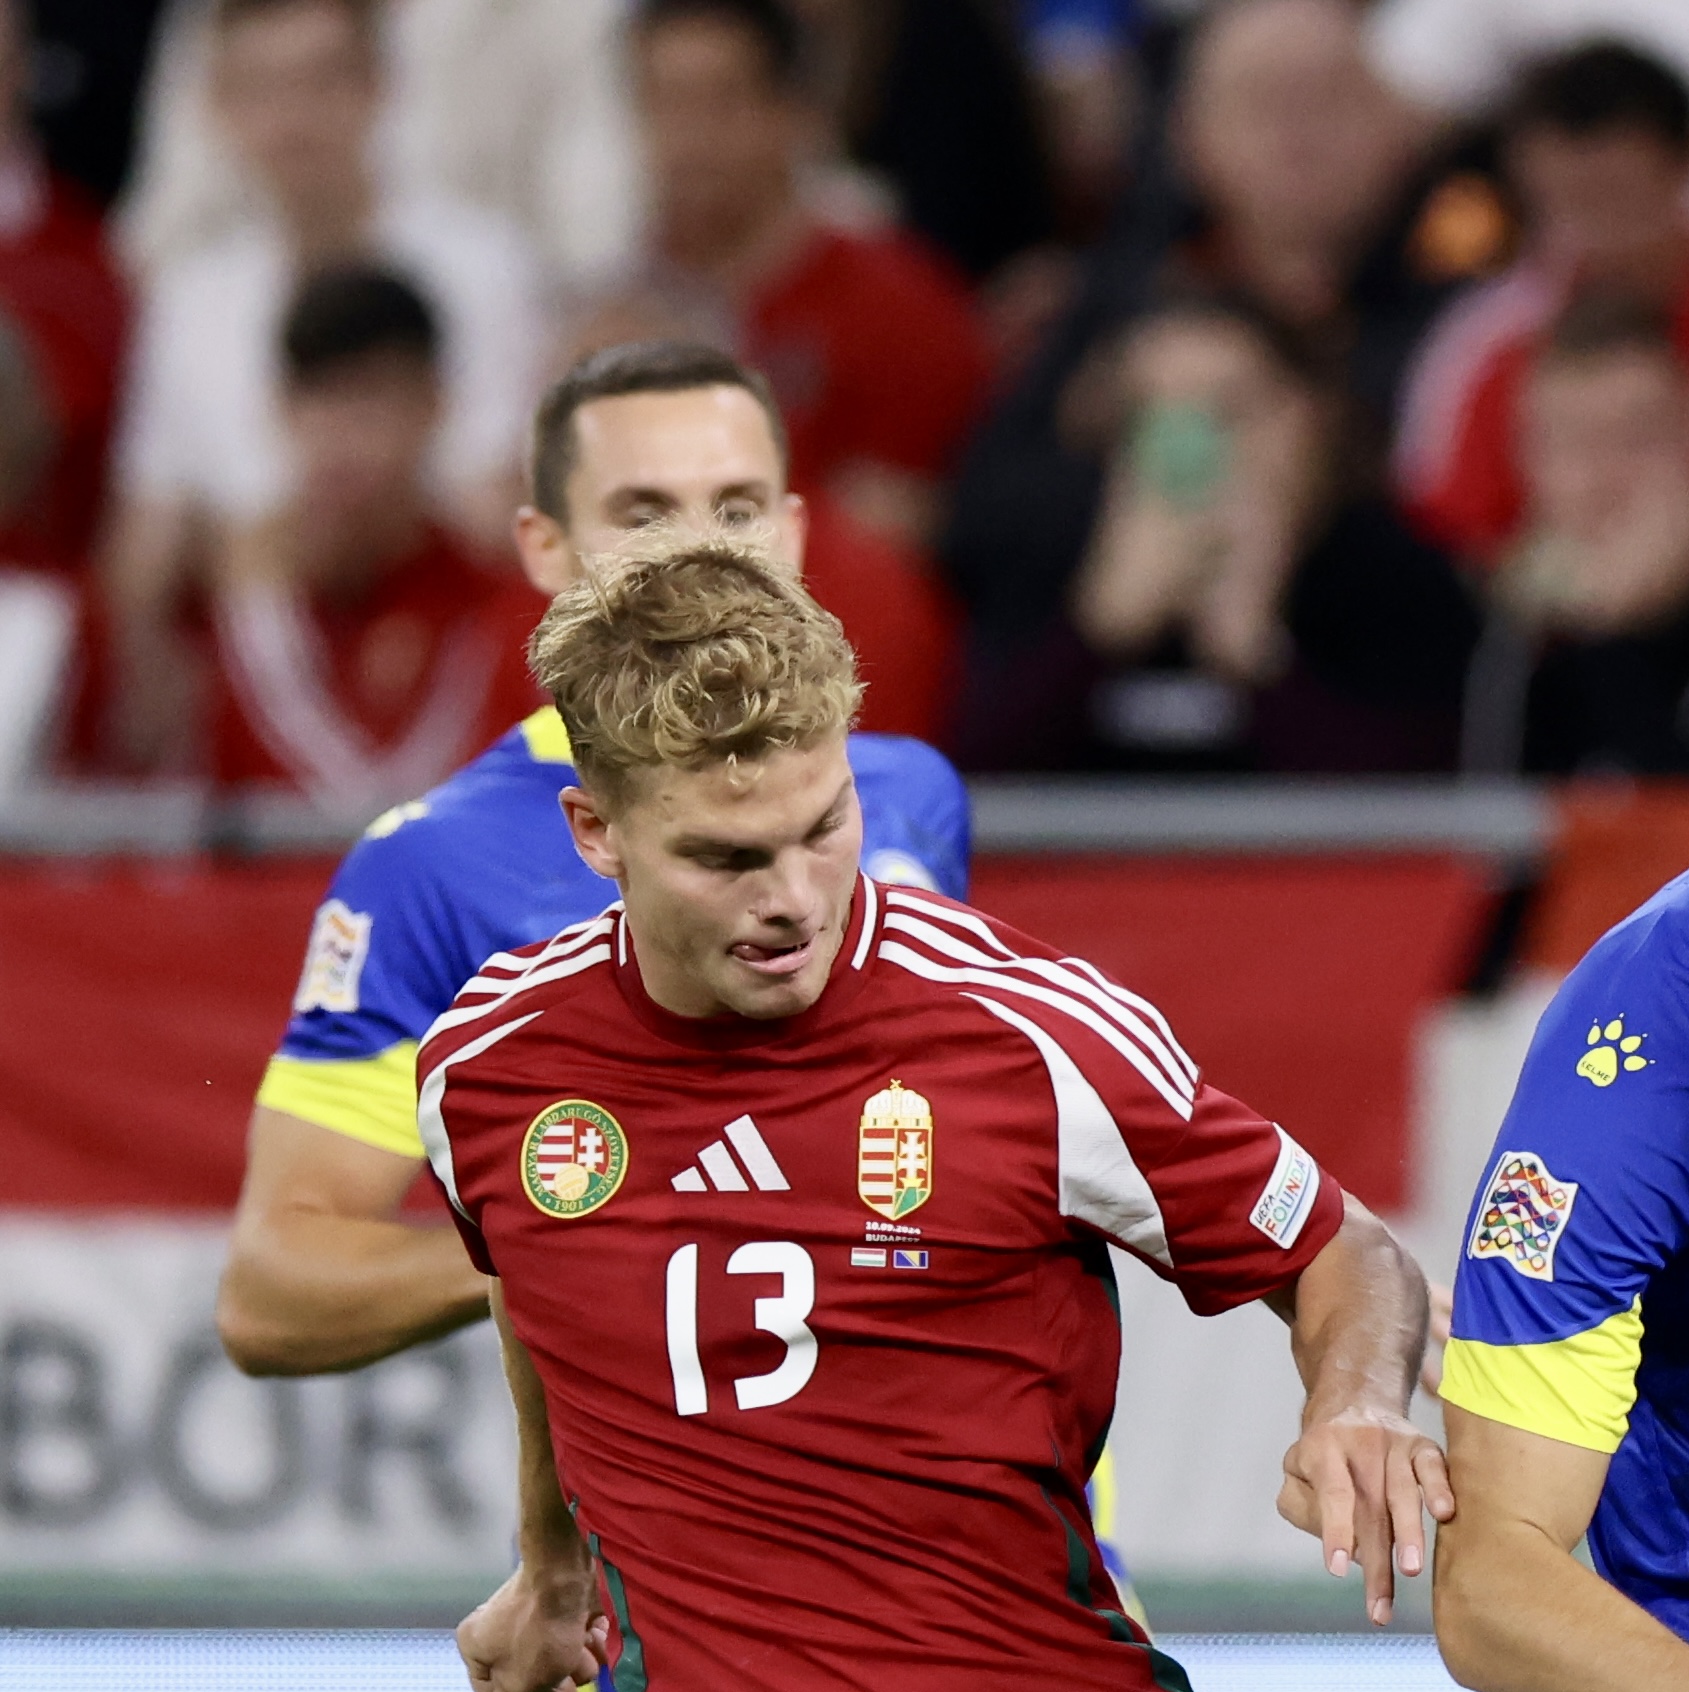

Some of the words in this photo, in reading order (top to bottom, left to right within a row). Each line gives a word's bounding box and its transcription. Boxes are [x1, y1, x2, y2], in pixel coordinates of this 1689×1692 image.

[554, 1200, 584, 1212] 1901
[1254, 1194, 1275, 1225] UEFA
[865, 1221, 922, 1235] 10.09.2024
[665, 1241, 818, 1417] 13
